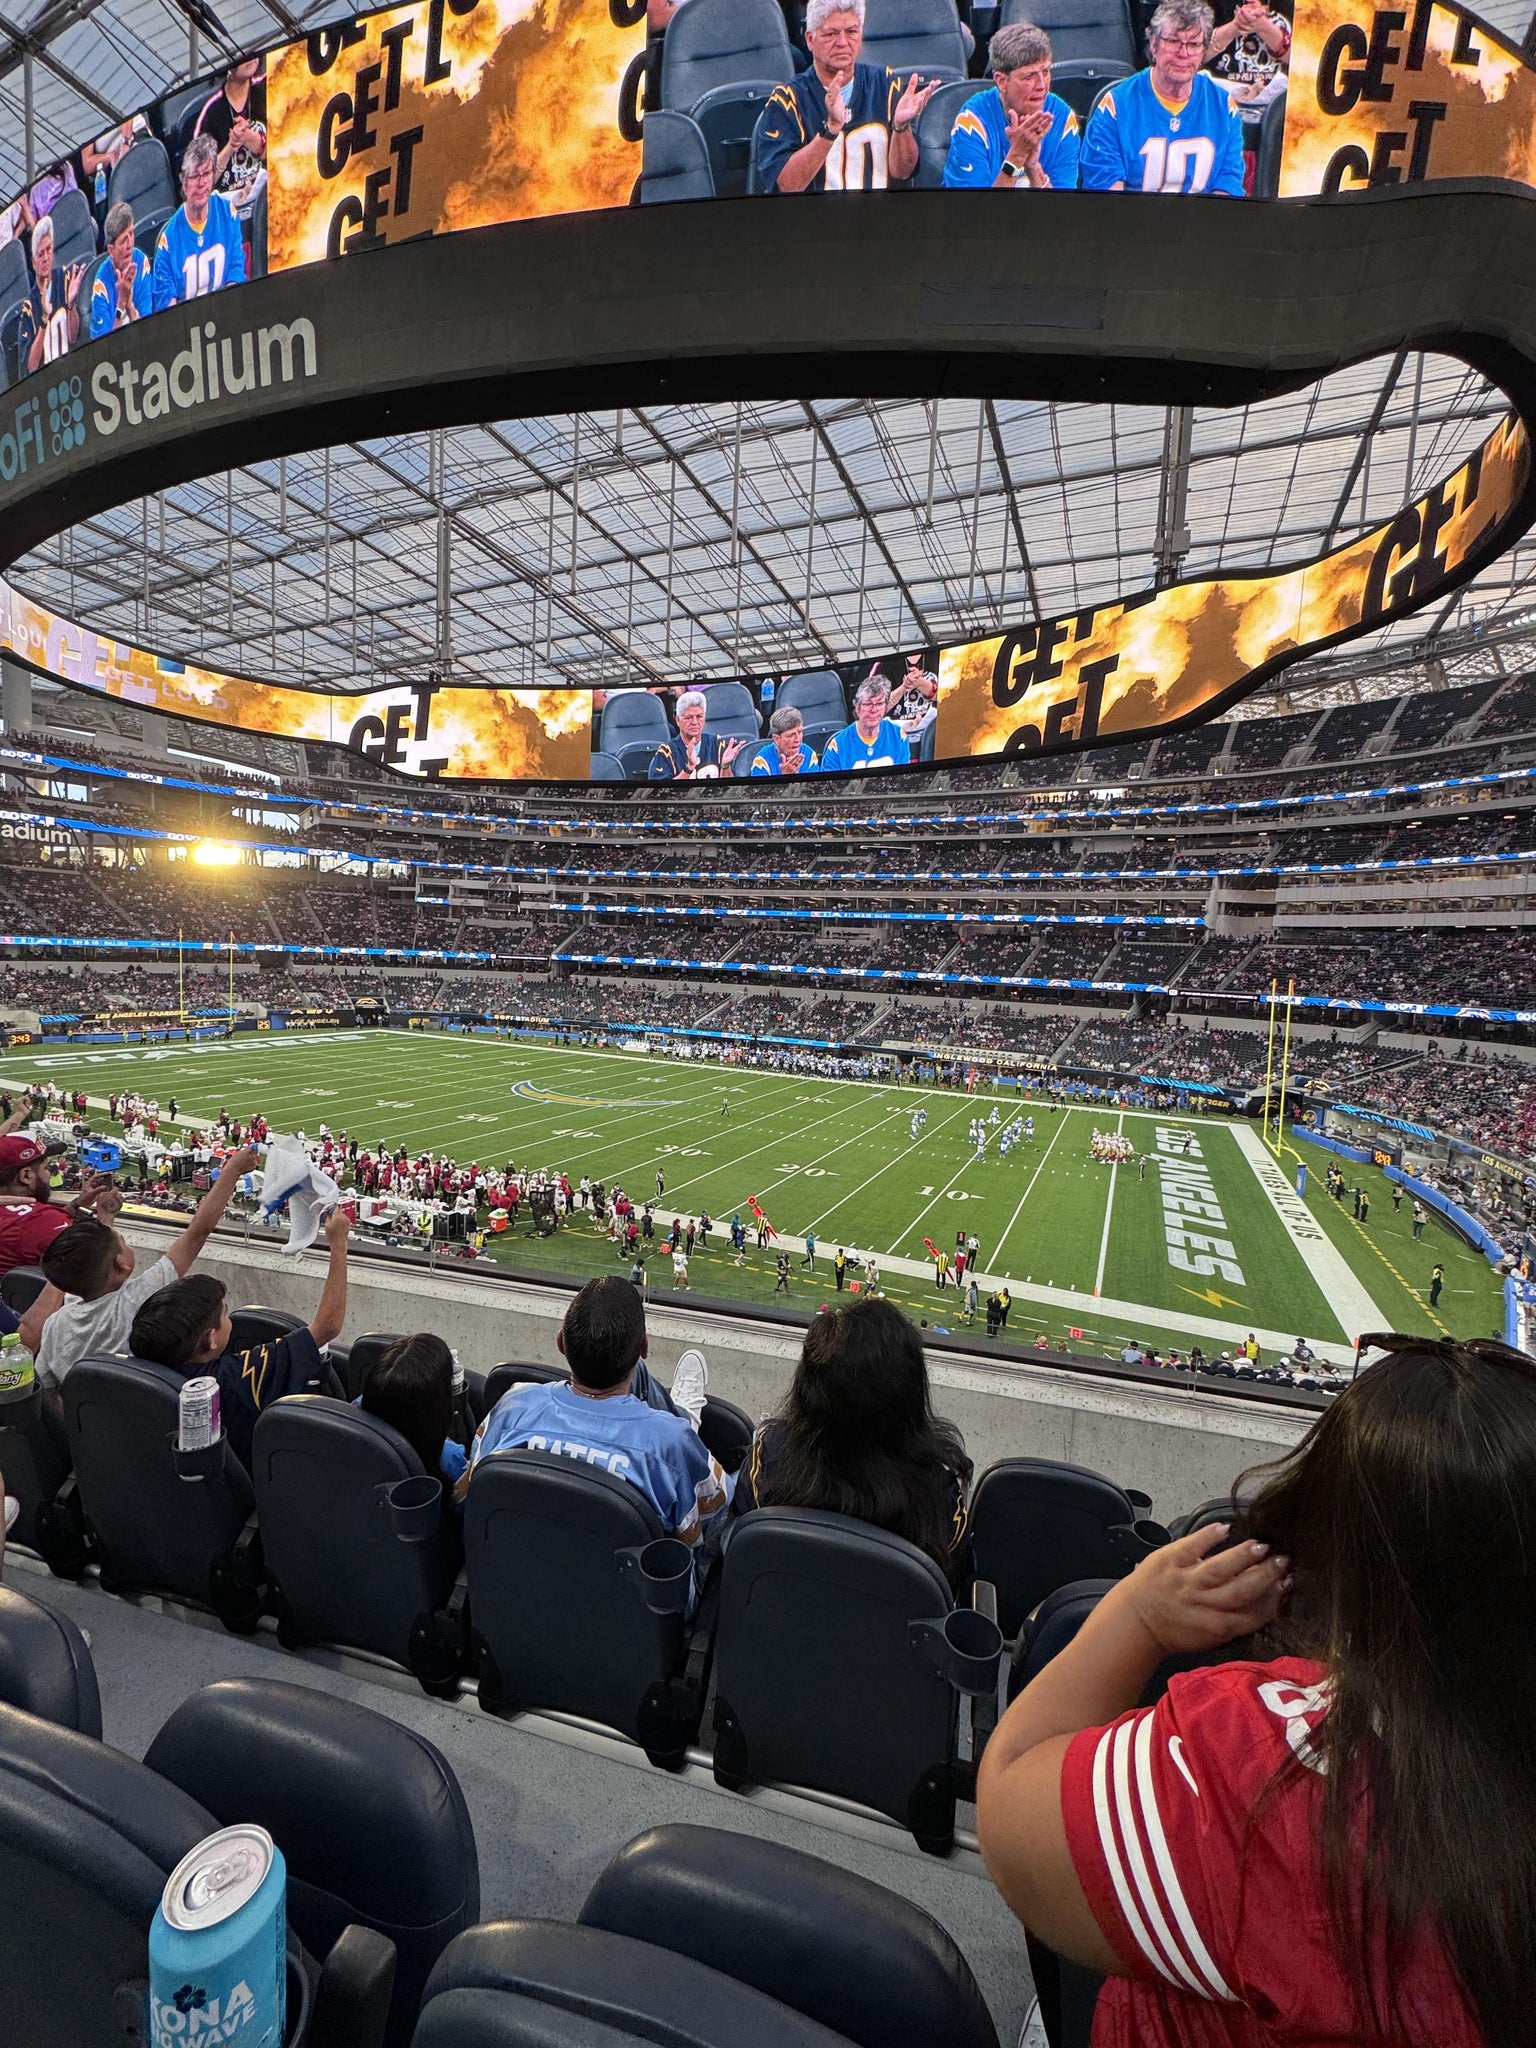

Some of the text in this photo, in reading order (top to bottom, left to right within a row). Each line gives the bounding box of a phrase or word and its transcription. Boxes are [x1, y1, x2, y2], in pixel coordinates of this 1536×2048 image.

[317, 19, 413, 180] GET
[92, 317, 317, 436] Stadium
[162, 683, 228, 710] LOD
[0, 822, 72, 844] adium
[515, 1015, 549, 1023] STADIUM
[33, 1035, 367, 1067] CHARGERS
[933, 1053, 1057, 1072] INGLEWOOD CALIFORNIA
[655, 1145, 701, 1156] 30
[774, 1163, 830, 1177] 20
[1481, 1154, 1524, 1180] LOS ANGELES
[915, 1185, 969, 1201] 10
[1150, 1152, 1247, 1286] ANGELES
[1282, 1209, 1312, 1223] OF
[1291, 1225, 1324, 1240] US
